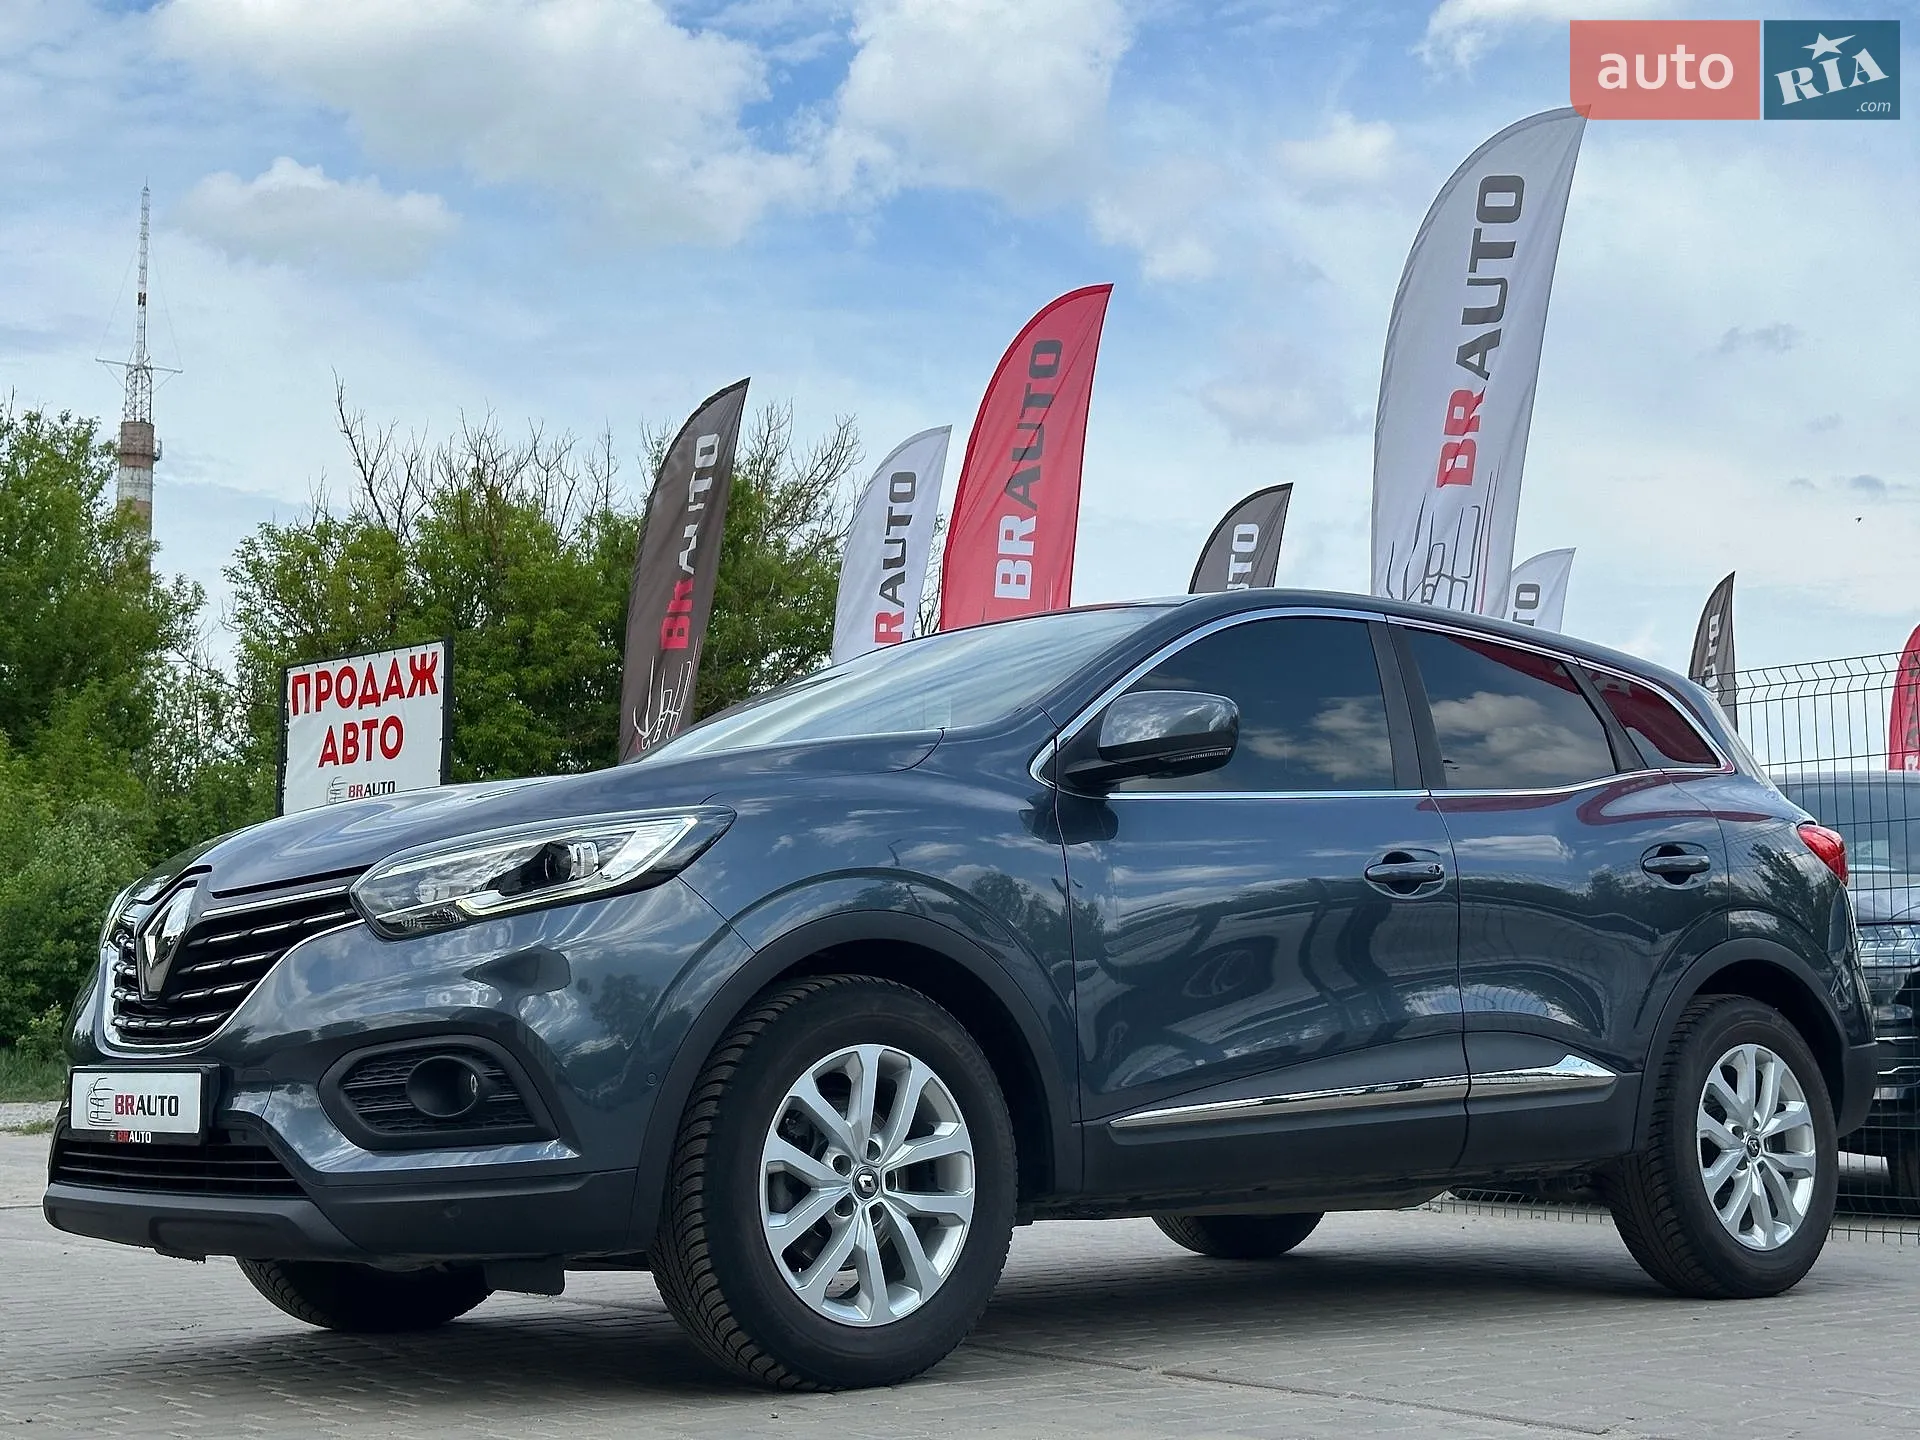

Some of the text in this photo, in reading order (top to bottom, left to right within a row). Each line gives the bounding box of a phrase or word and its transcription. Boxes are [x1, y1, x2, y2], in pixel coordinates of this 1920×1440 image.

[1436, 174, 1525, 488] BRAUTO
[994, 339, 1063, 600] BRAUTO
[291, 652, 439, 716] ПРОДАЖ
[318, 715, 404, 768] АВТО
[348, 780, 396, 798] BRAUTO
[114, 1094, 179, 1117] BRAUTO
[116, 1130, 152, 1144] BRAUTO
